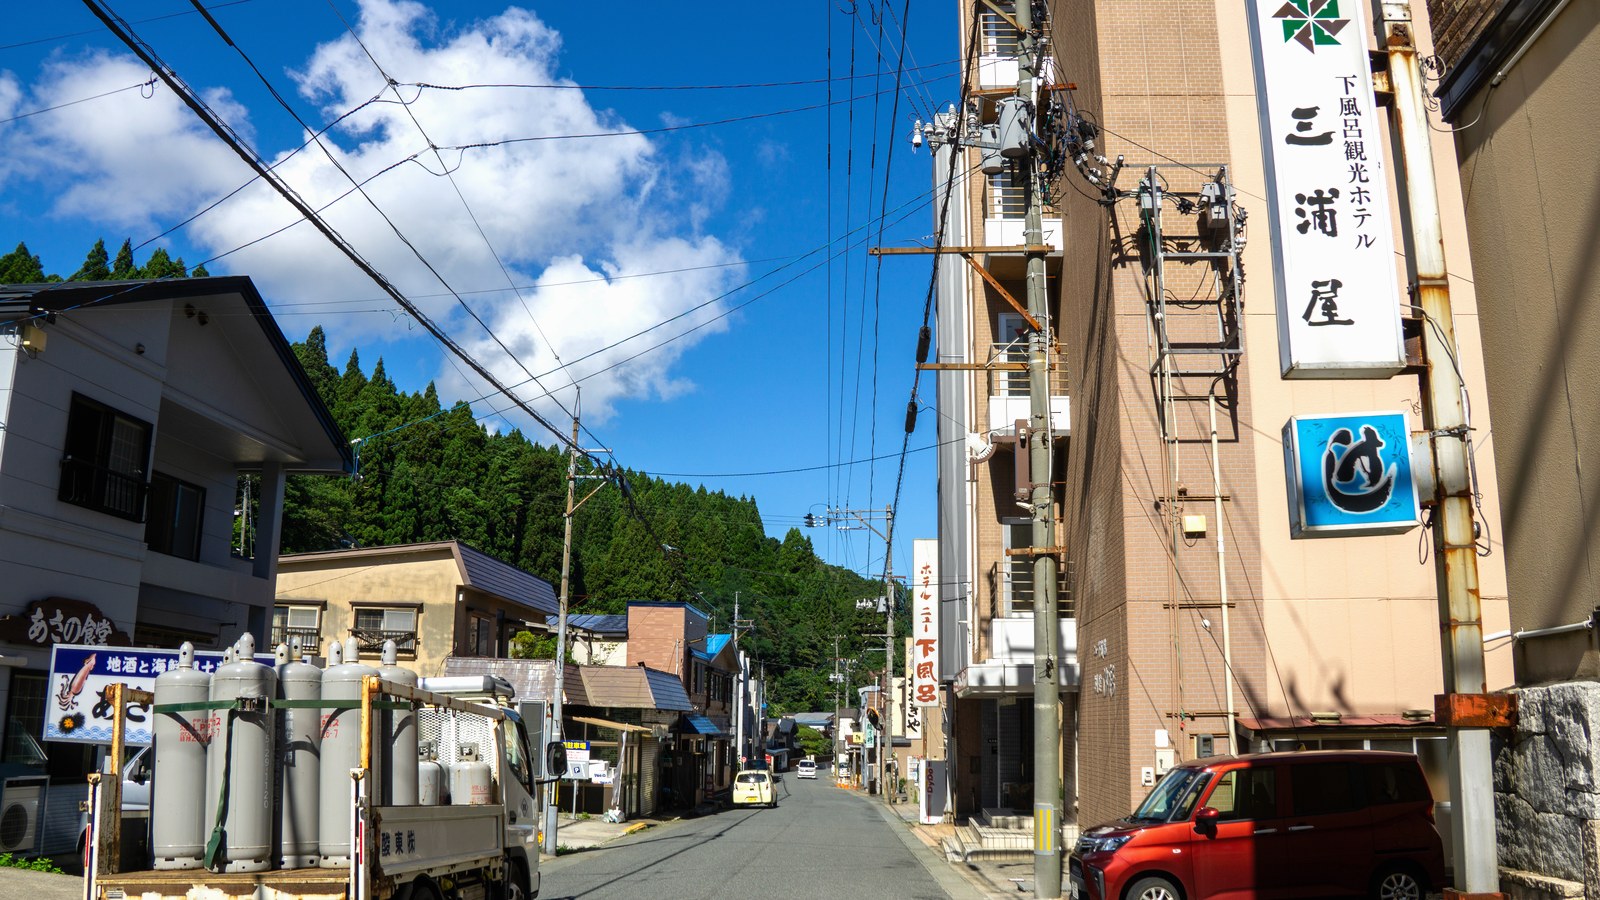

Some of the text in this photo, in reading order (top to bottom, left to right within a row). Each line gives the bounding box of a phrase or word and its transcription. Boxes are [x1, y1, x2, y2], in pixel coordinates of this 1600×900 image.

[1284, 105, 1355, 327] 三浦屋
[1335, 74, 1377, 249] 下風呂観光ホテル
[28, 606, 113, 646] あさの食堂
[915, 638, 938, 703] 下風呂
